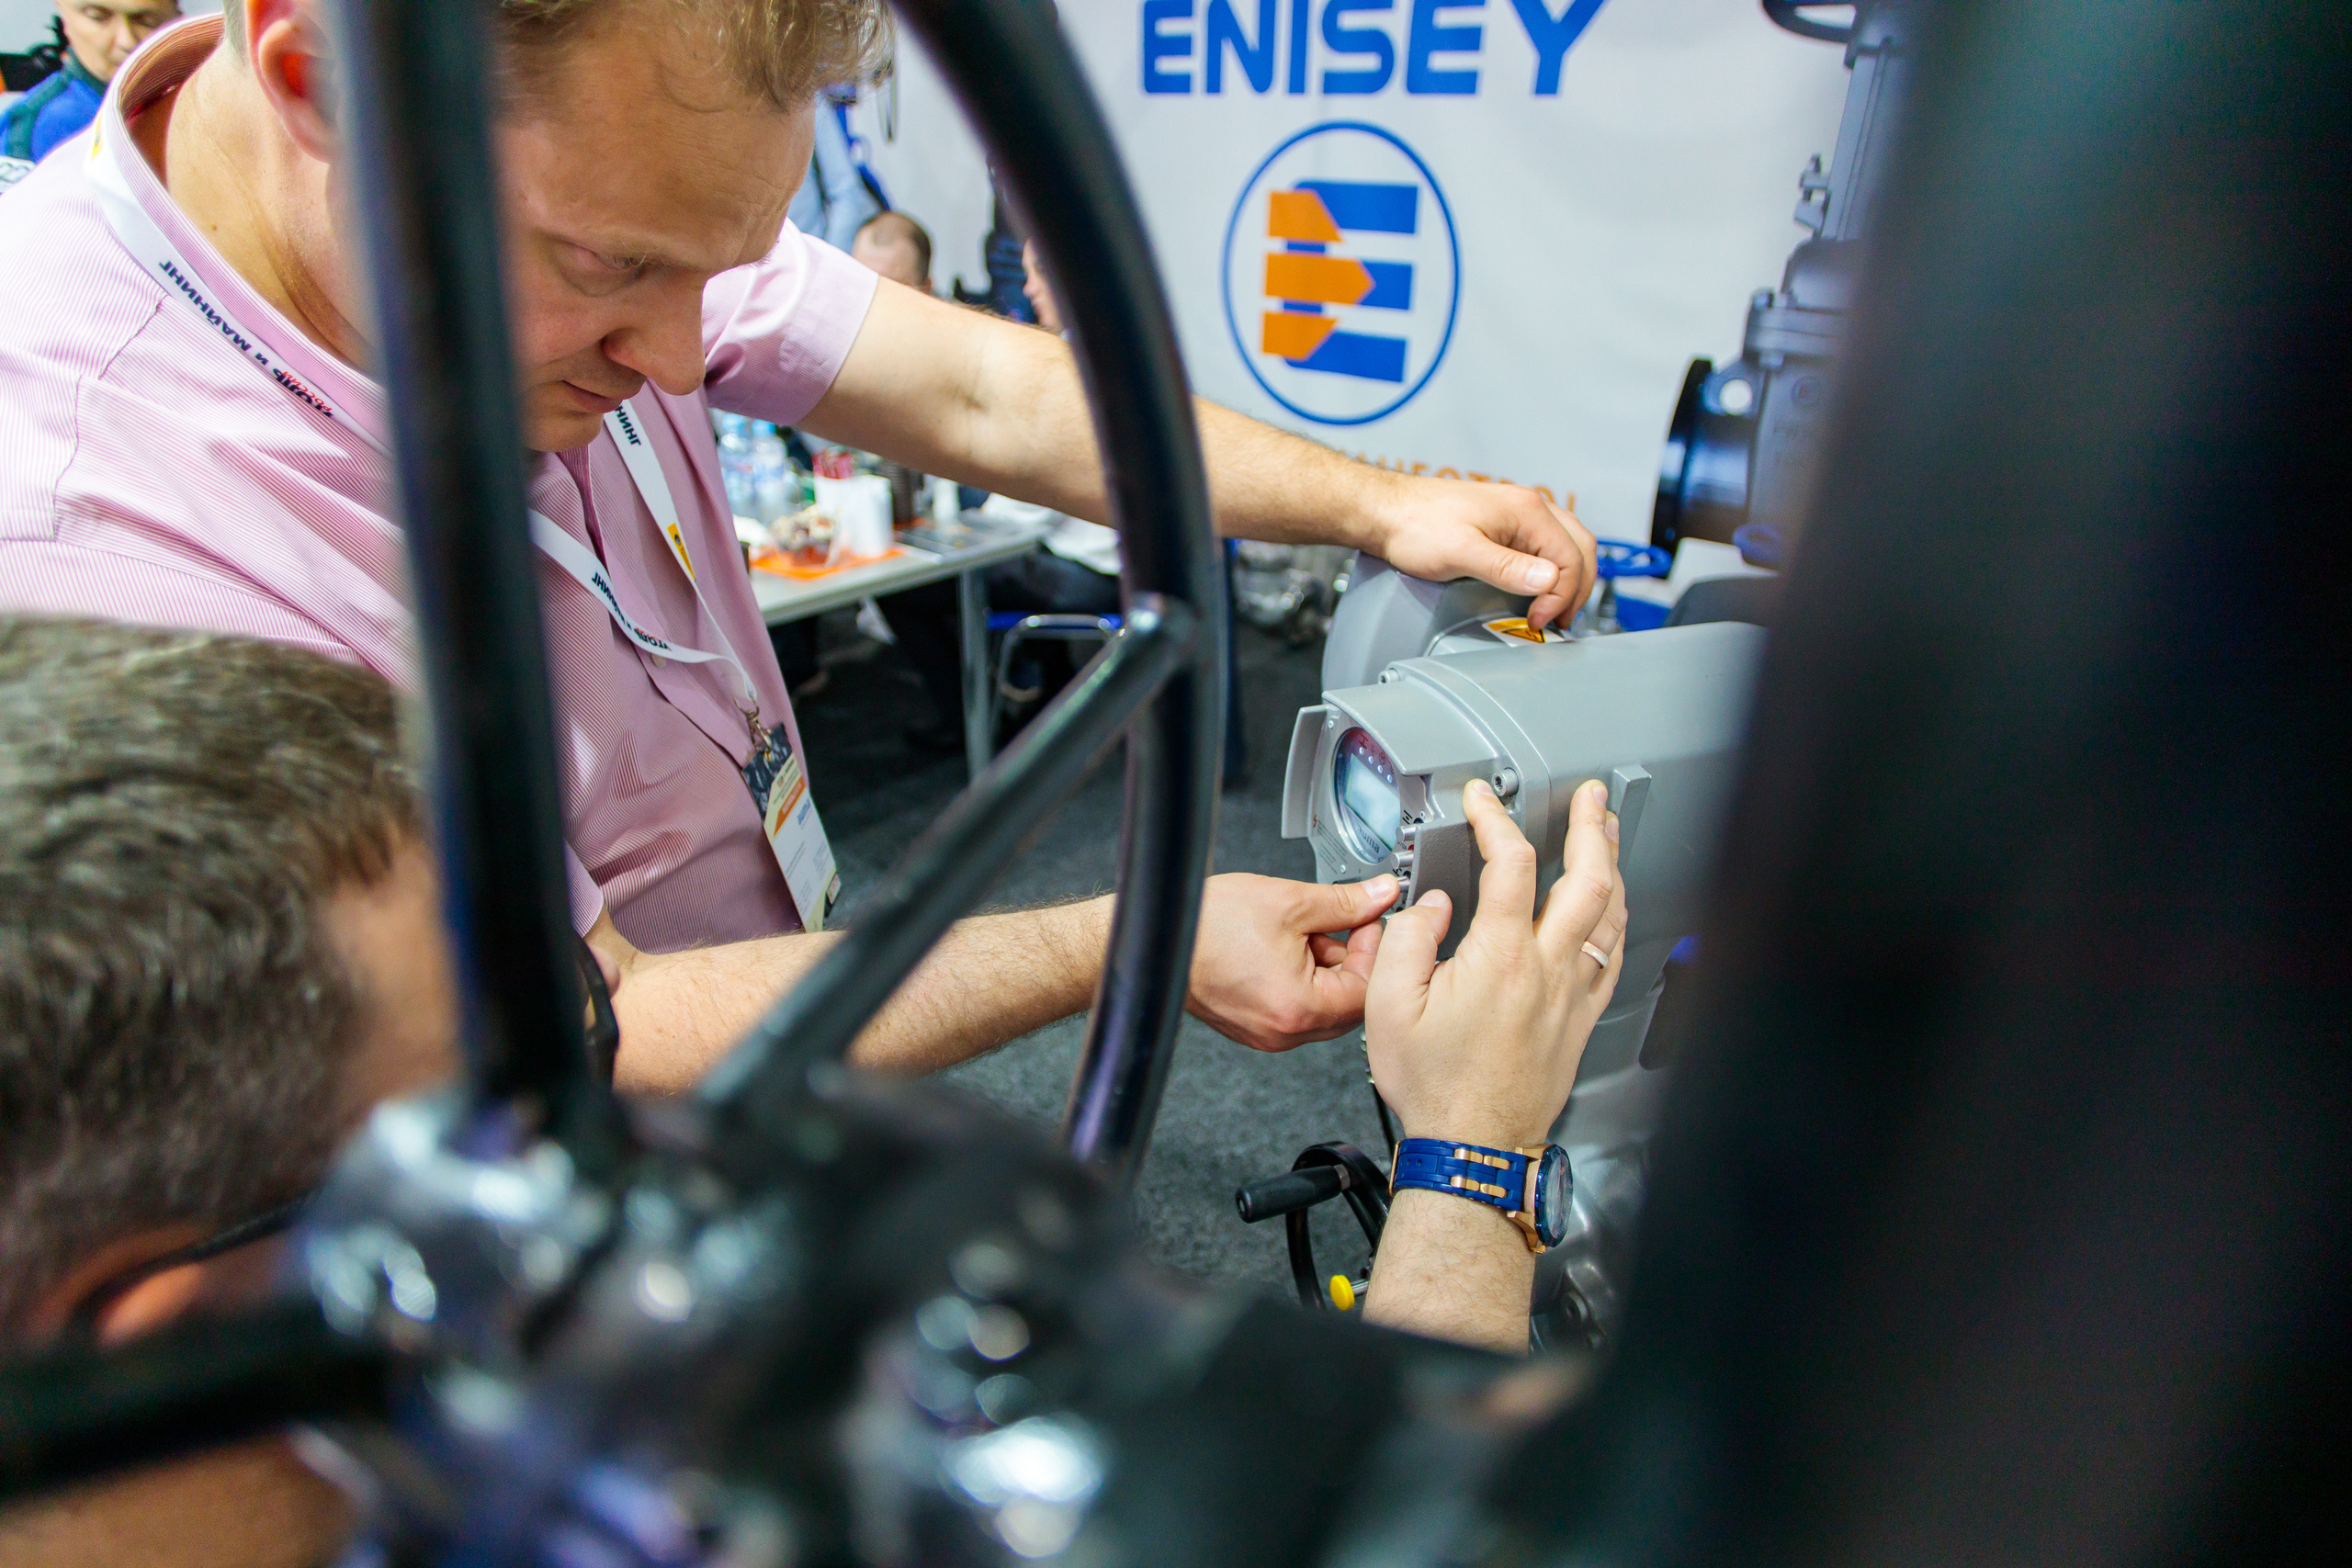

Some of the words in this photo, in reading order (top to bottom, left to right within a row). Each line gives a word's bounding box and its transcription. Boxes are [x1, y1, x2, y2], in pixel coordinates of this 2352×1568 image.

[1143, 0, 1610, 95] ENISEY
[159, 260, 252, 352] МАЙНИНГ
[282, 371, 333, 412] РОССИИ
[615, 405, 641, 446] НИНГ
